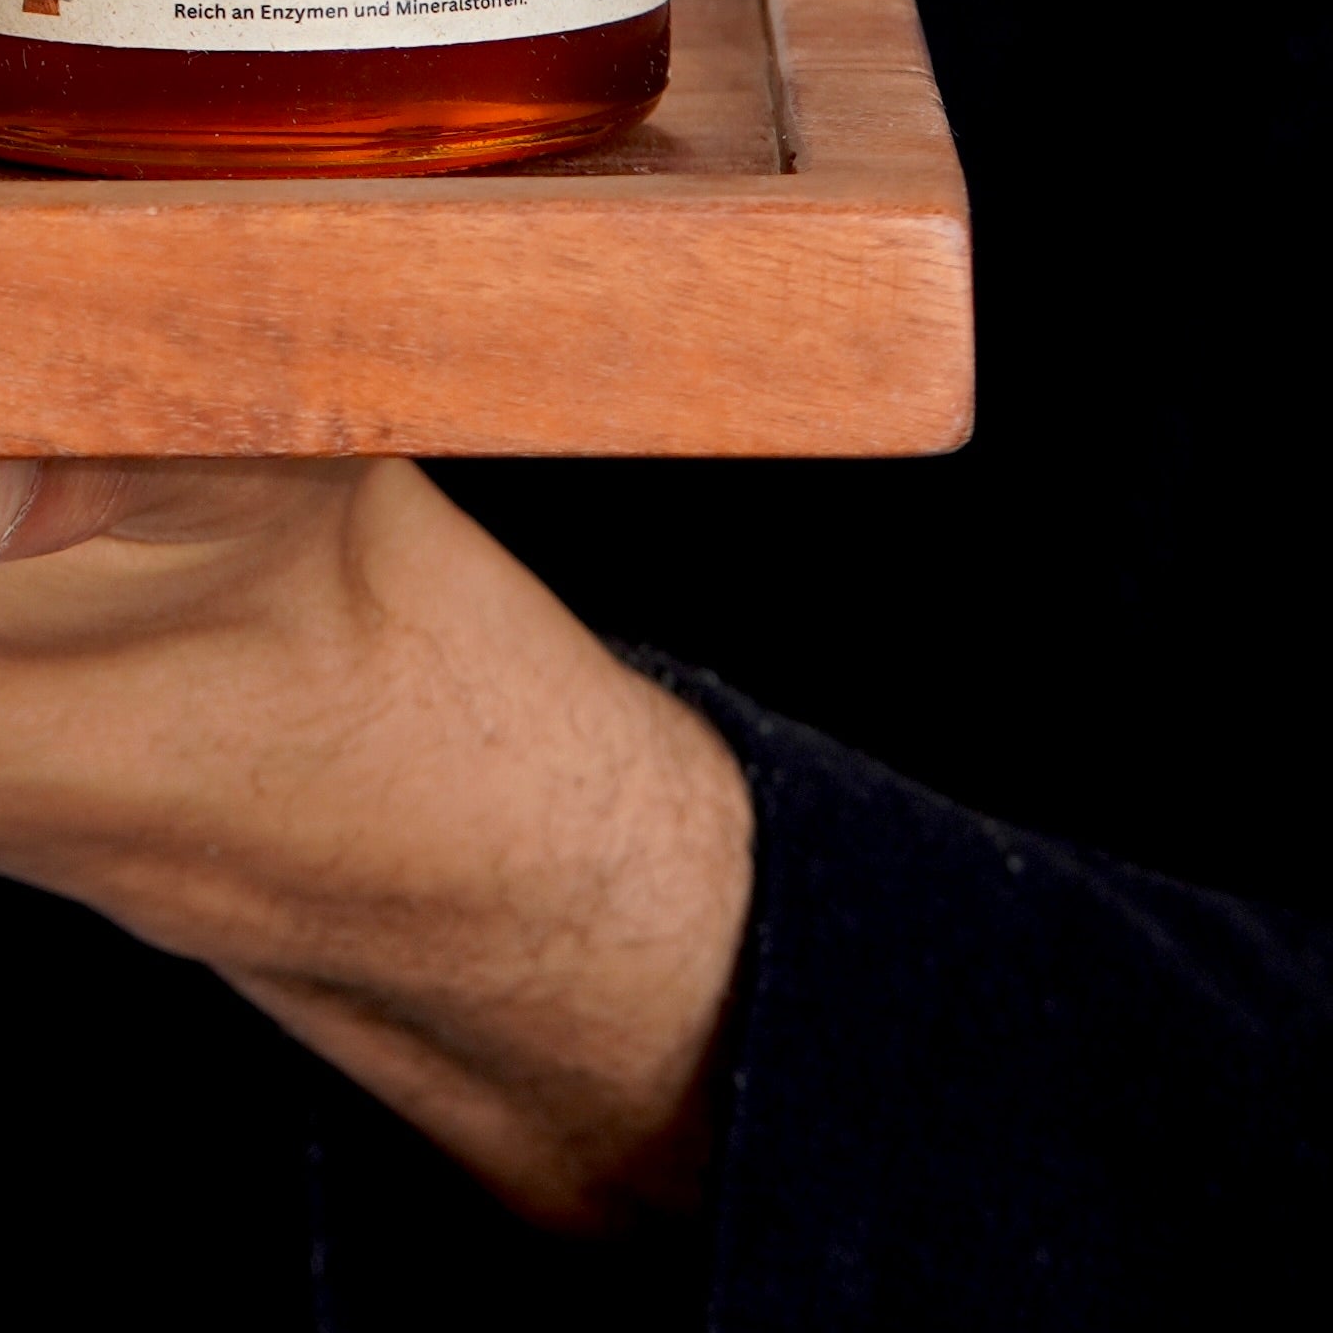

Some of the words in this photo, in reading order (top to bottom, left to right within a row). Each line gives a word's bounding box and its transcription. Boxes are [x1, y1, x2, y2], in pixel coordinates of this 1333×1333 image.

[174, 3, 226, 19] Reich
[232, 8, 254, 20] an
[261, 5, 348, 24] Enzymen
[355, 1, 389, 17] und
